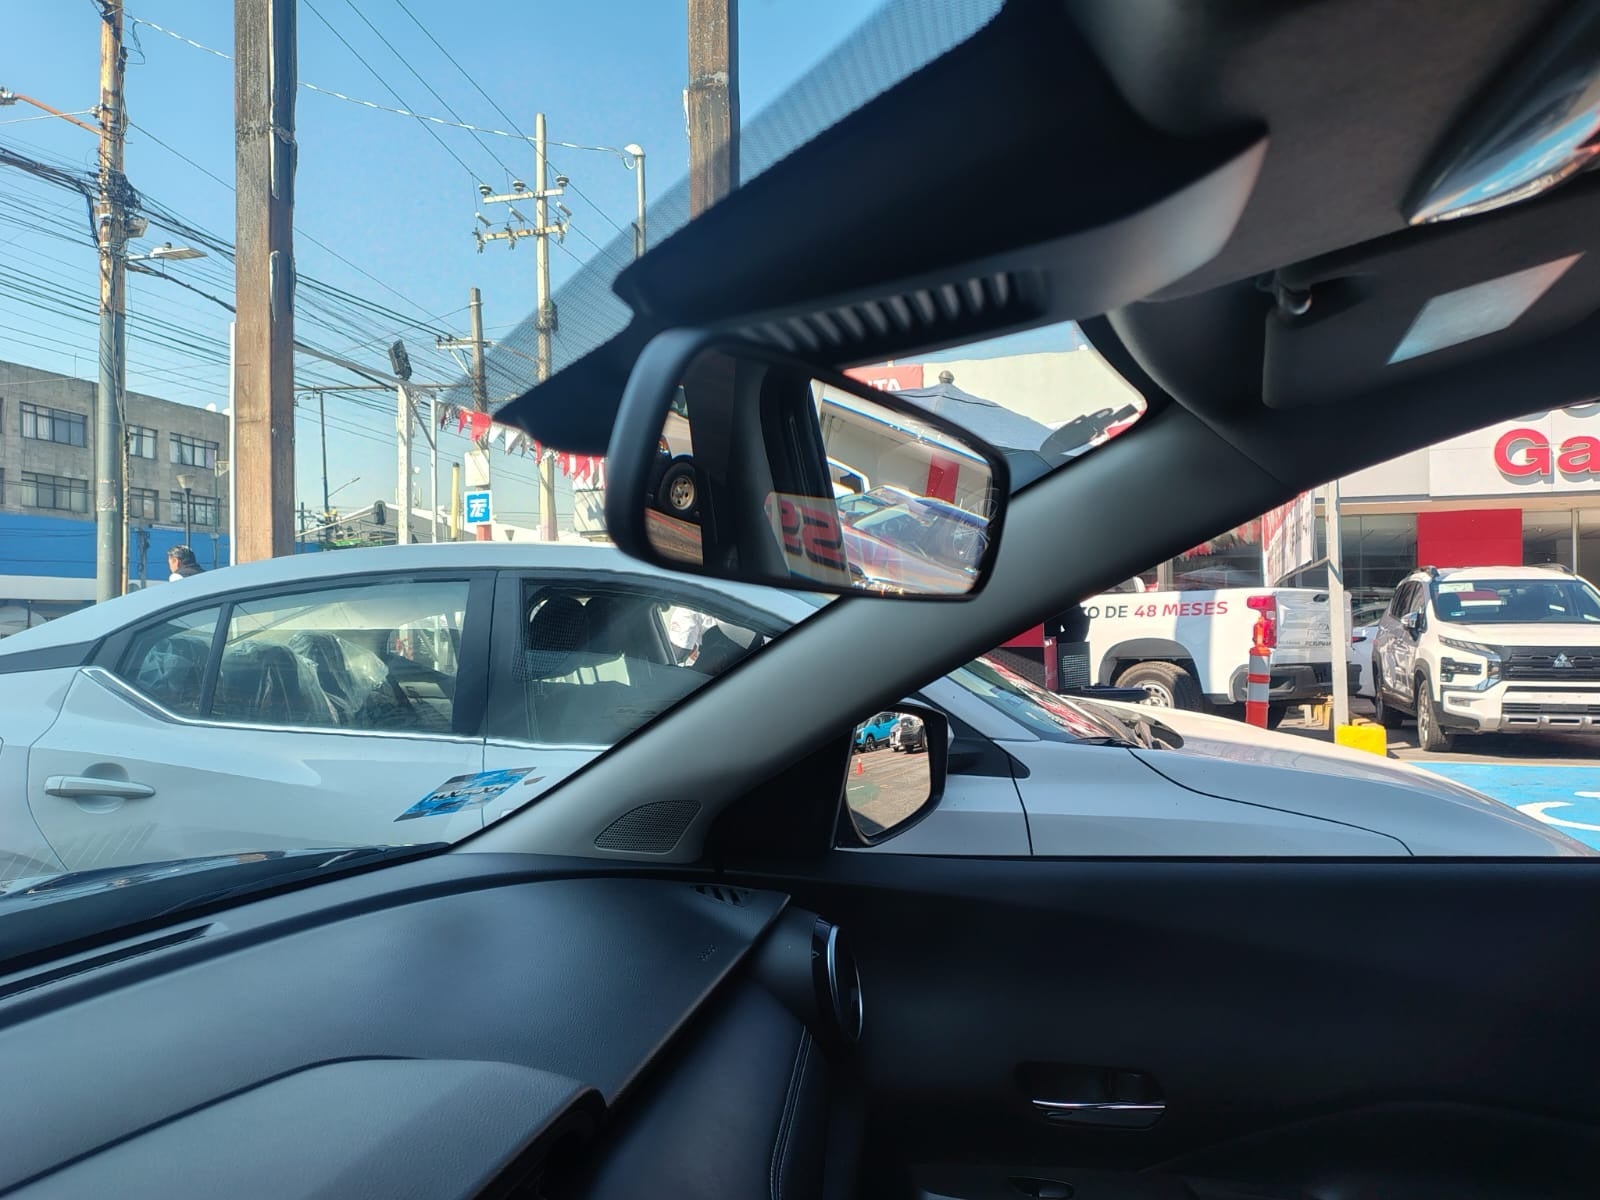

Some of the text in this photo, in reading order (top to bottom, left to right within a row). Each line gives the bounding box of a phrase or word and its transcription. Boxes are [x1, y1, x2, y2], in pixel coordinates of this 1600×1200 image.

[1105, 605, 1128, 618] DE
[1134, 604, 1157, 618] 48
[1162, 601, 1228, 617] MESES
